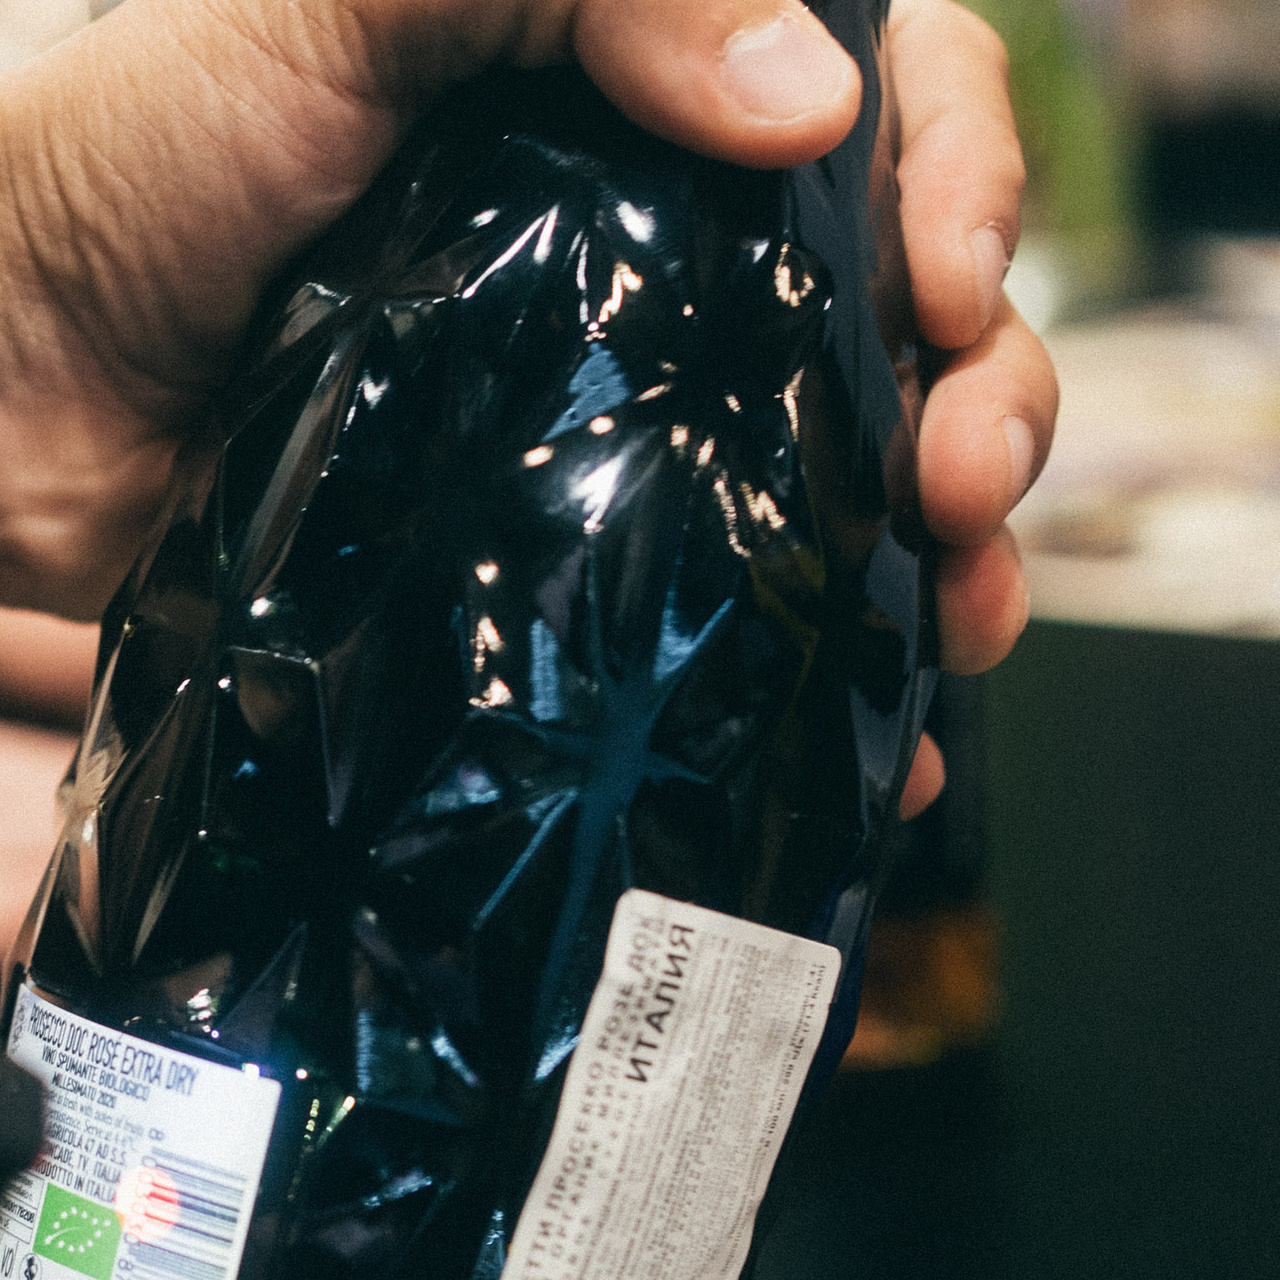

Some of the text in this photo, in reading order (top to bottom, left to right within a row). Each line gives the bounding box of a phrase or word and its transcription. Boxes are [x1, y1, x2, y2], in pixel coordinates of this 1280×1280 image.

[623, 920, 695, 1085] ИТАЛИЯ
[24, 1003, 69, 1049] PROSECCO
[61, 1022, 91, 1057] DOC
[117, 1045, 169, 1086] EXTRA
[162, 1060, 199, 1095] DRY
[54, 1051, 100, 1082] SPUMANTE
[97, 1069, 151, 1101] BIOLOGICO
